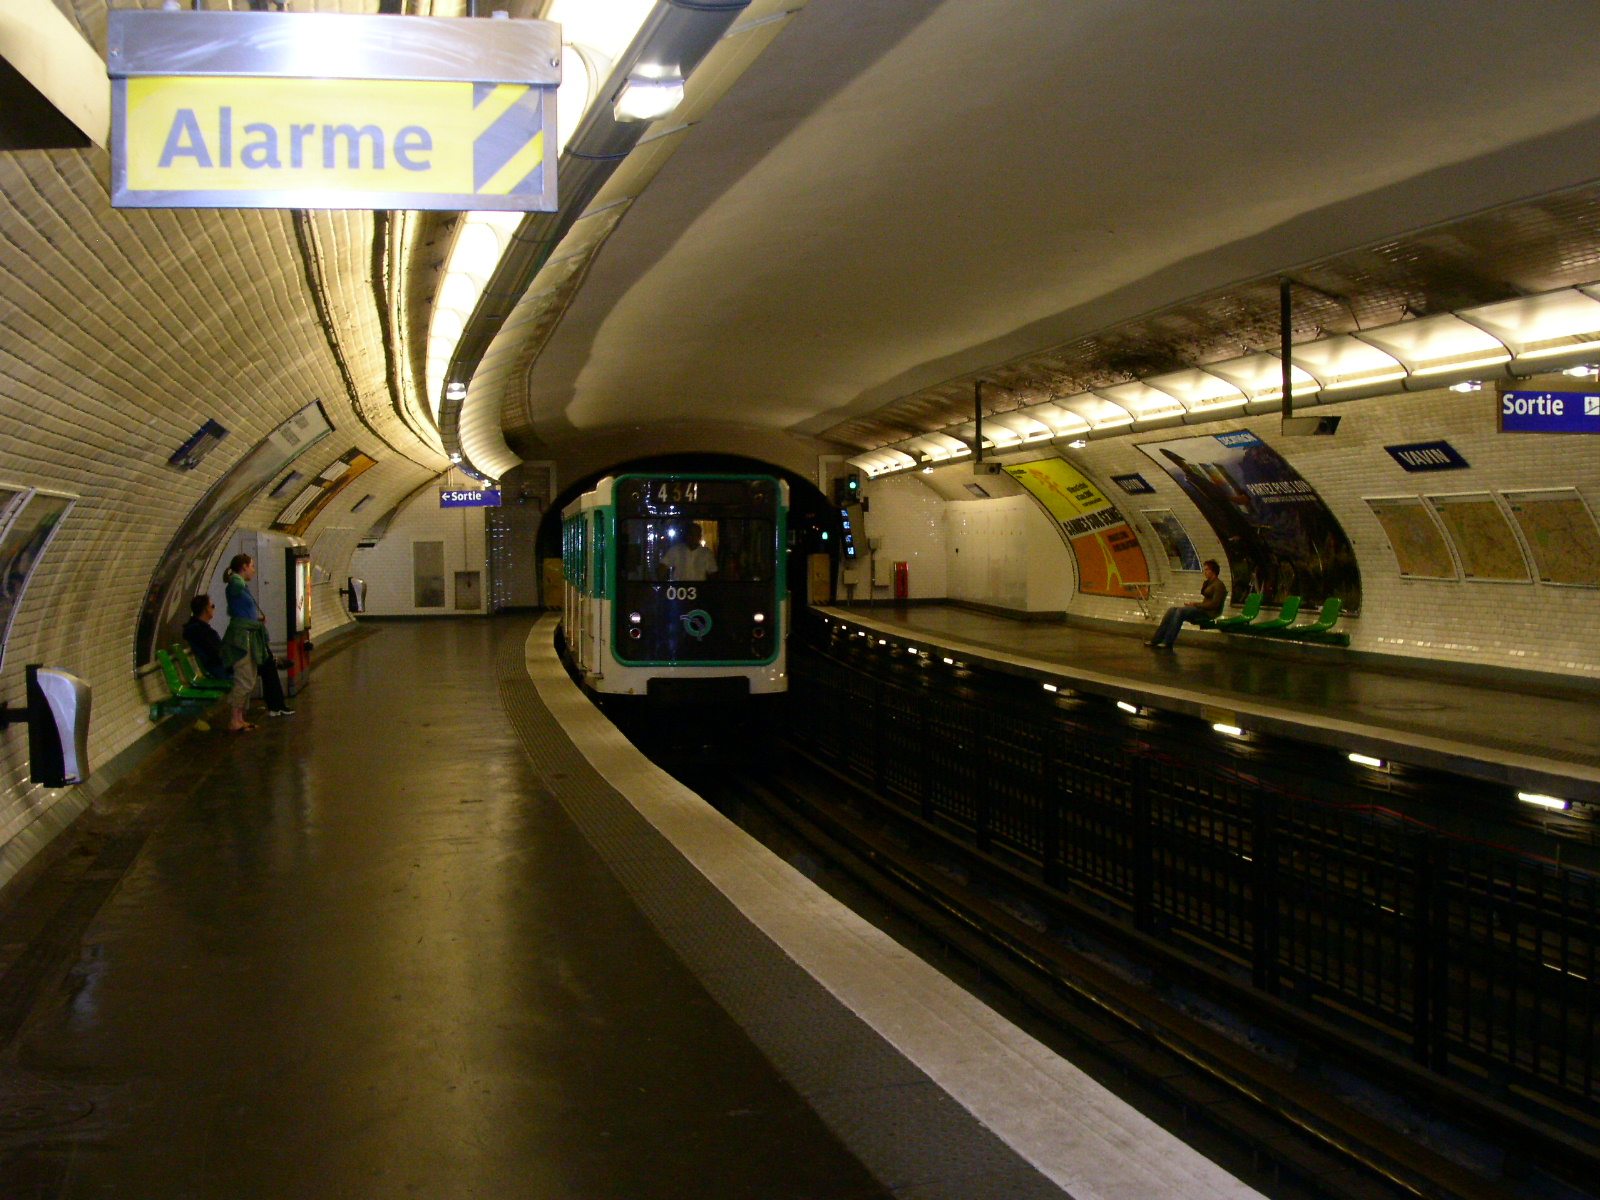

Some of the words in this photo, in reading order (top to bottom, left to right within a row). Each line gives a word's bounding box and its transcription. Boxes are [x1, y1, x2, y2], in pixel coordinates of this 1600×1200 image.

[157, 107, 432, 171] Alarme
[1503, 393, 1564, 415] Sortie
[1398, 448, 1452, 466] VAVIN
[451, 491, 482, 501] Sortie
[667, 587, 697, 600] 003
